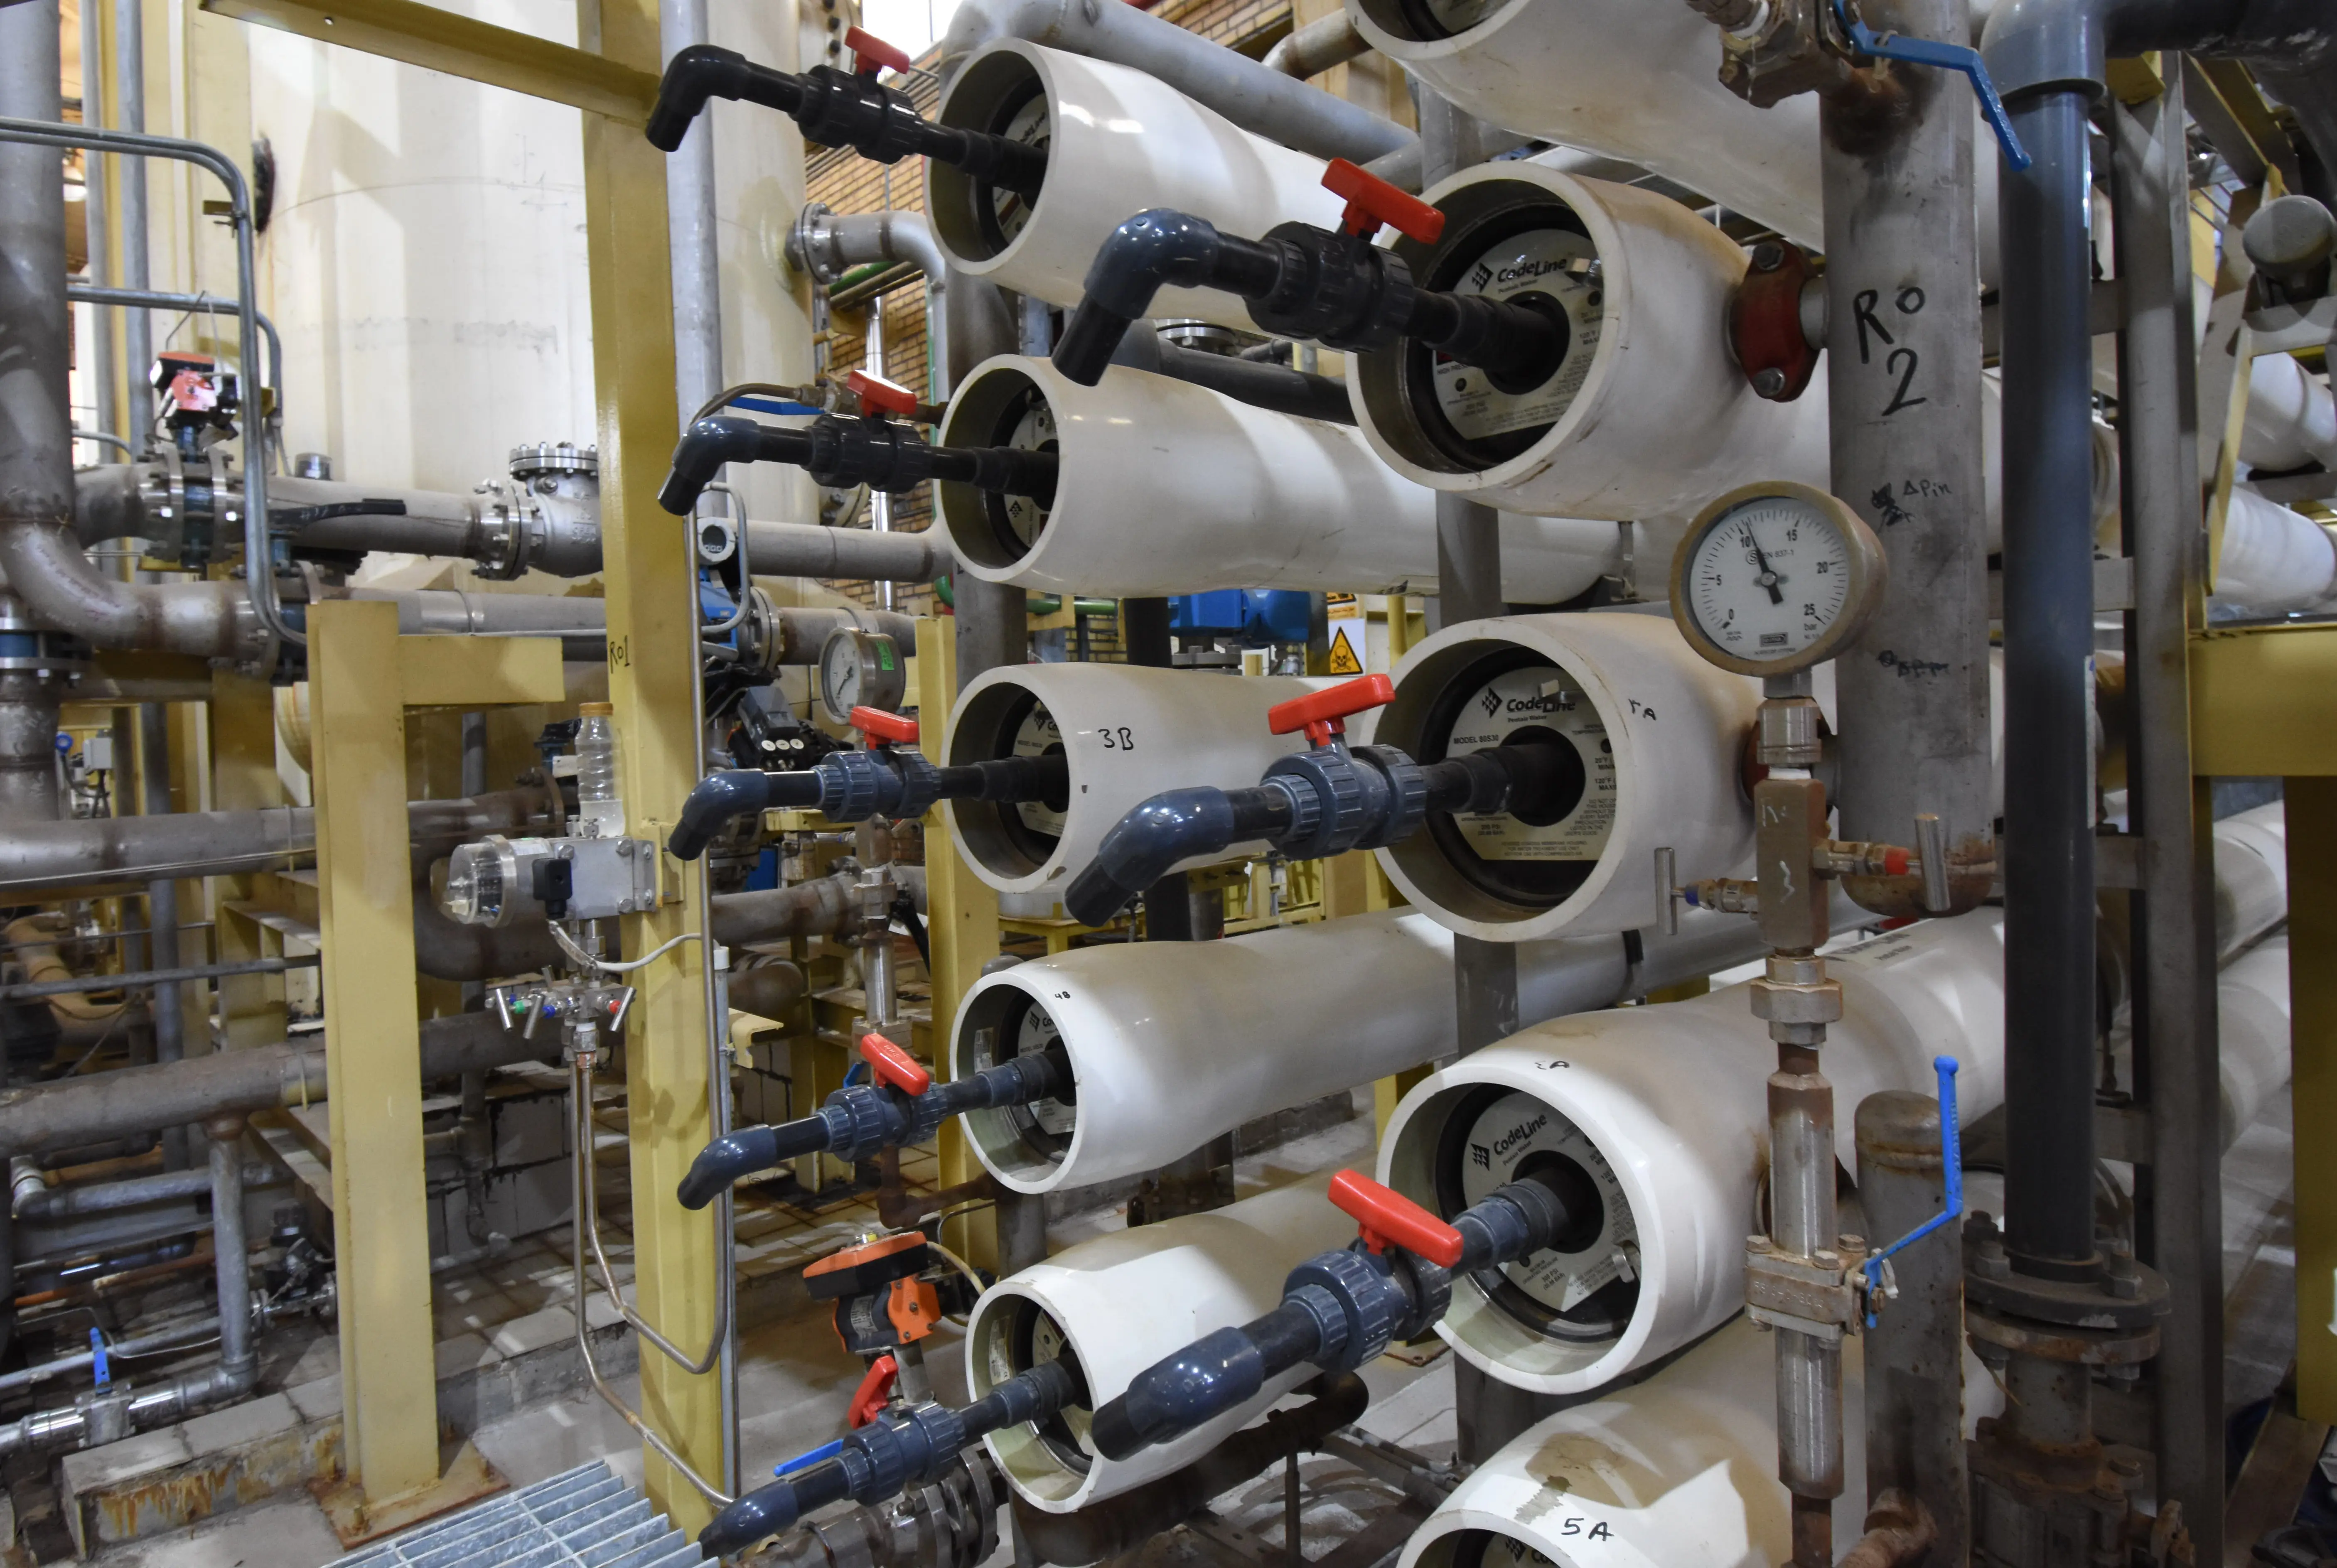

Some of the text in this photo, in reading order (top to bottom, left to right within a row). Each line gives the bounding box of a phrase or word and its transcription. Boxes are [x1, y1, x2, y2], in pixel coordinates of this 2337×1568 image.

[1497, 257, 1567, 283] CodeLine
[1882, 348, 1927, 416] 2
[1740, 536, 1751, 548] 10
[1787, 530, 1797, 542] 15
[1816, 562, 1828, 574] 20
[1716, 575, 1722, 586] 5
[1728, 609, 1734, 620] 0
[1804, 604, 1816, 616] 25
[1506, 697, 1575, 713] CodeLine
[1098, 727, 1134, 751] 3B
[1454, 736, 1478, 744] MODEL
[1493, 1113, 1547, 1156] CodeLine
[1560, 1517, 1615, 1541] 5A
